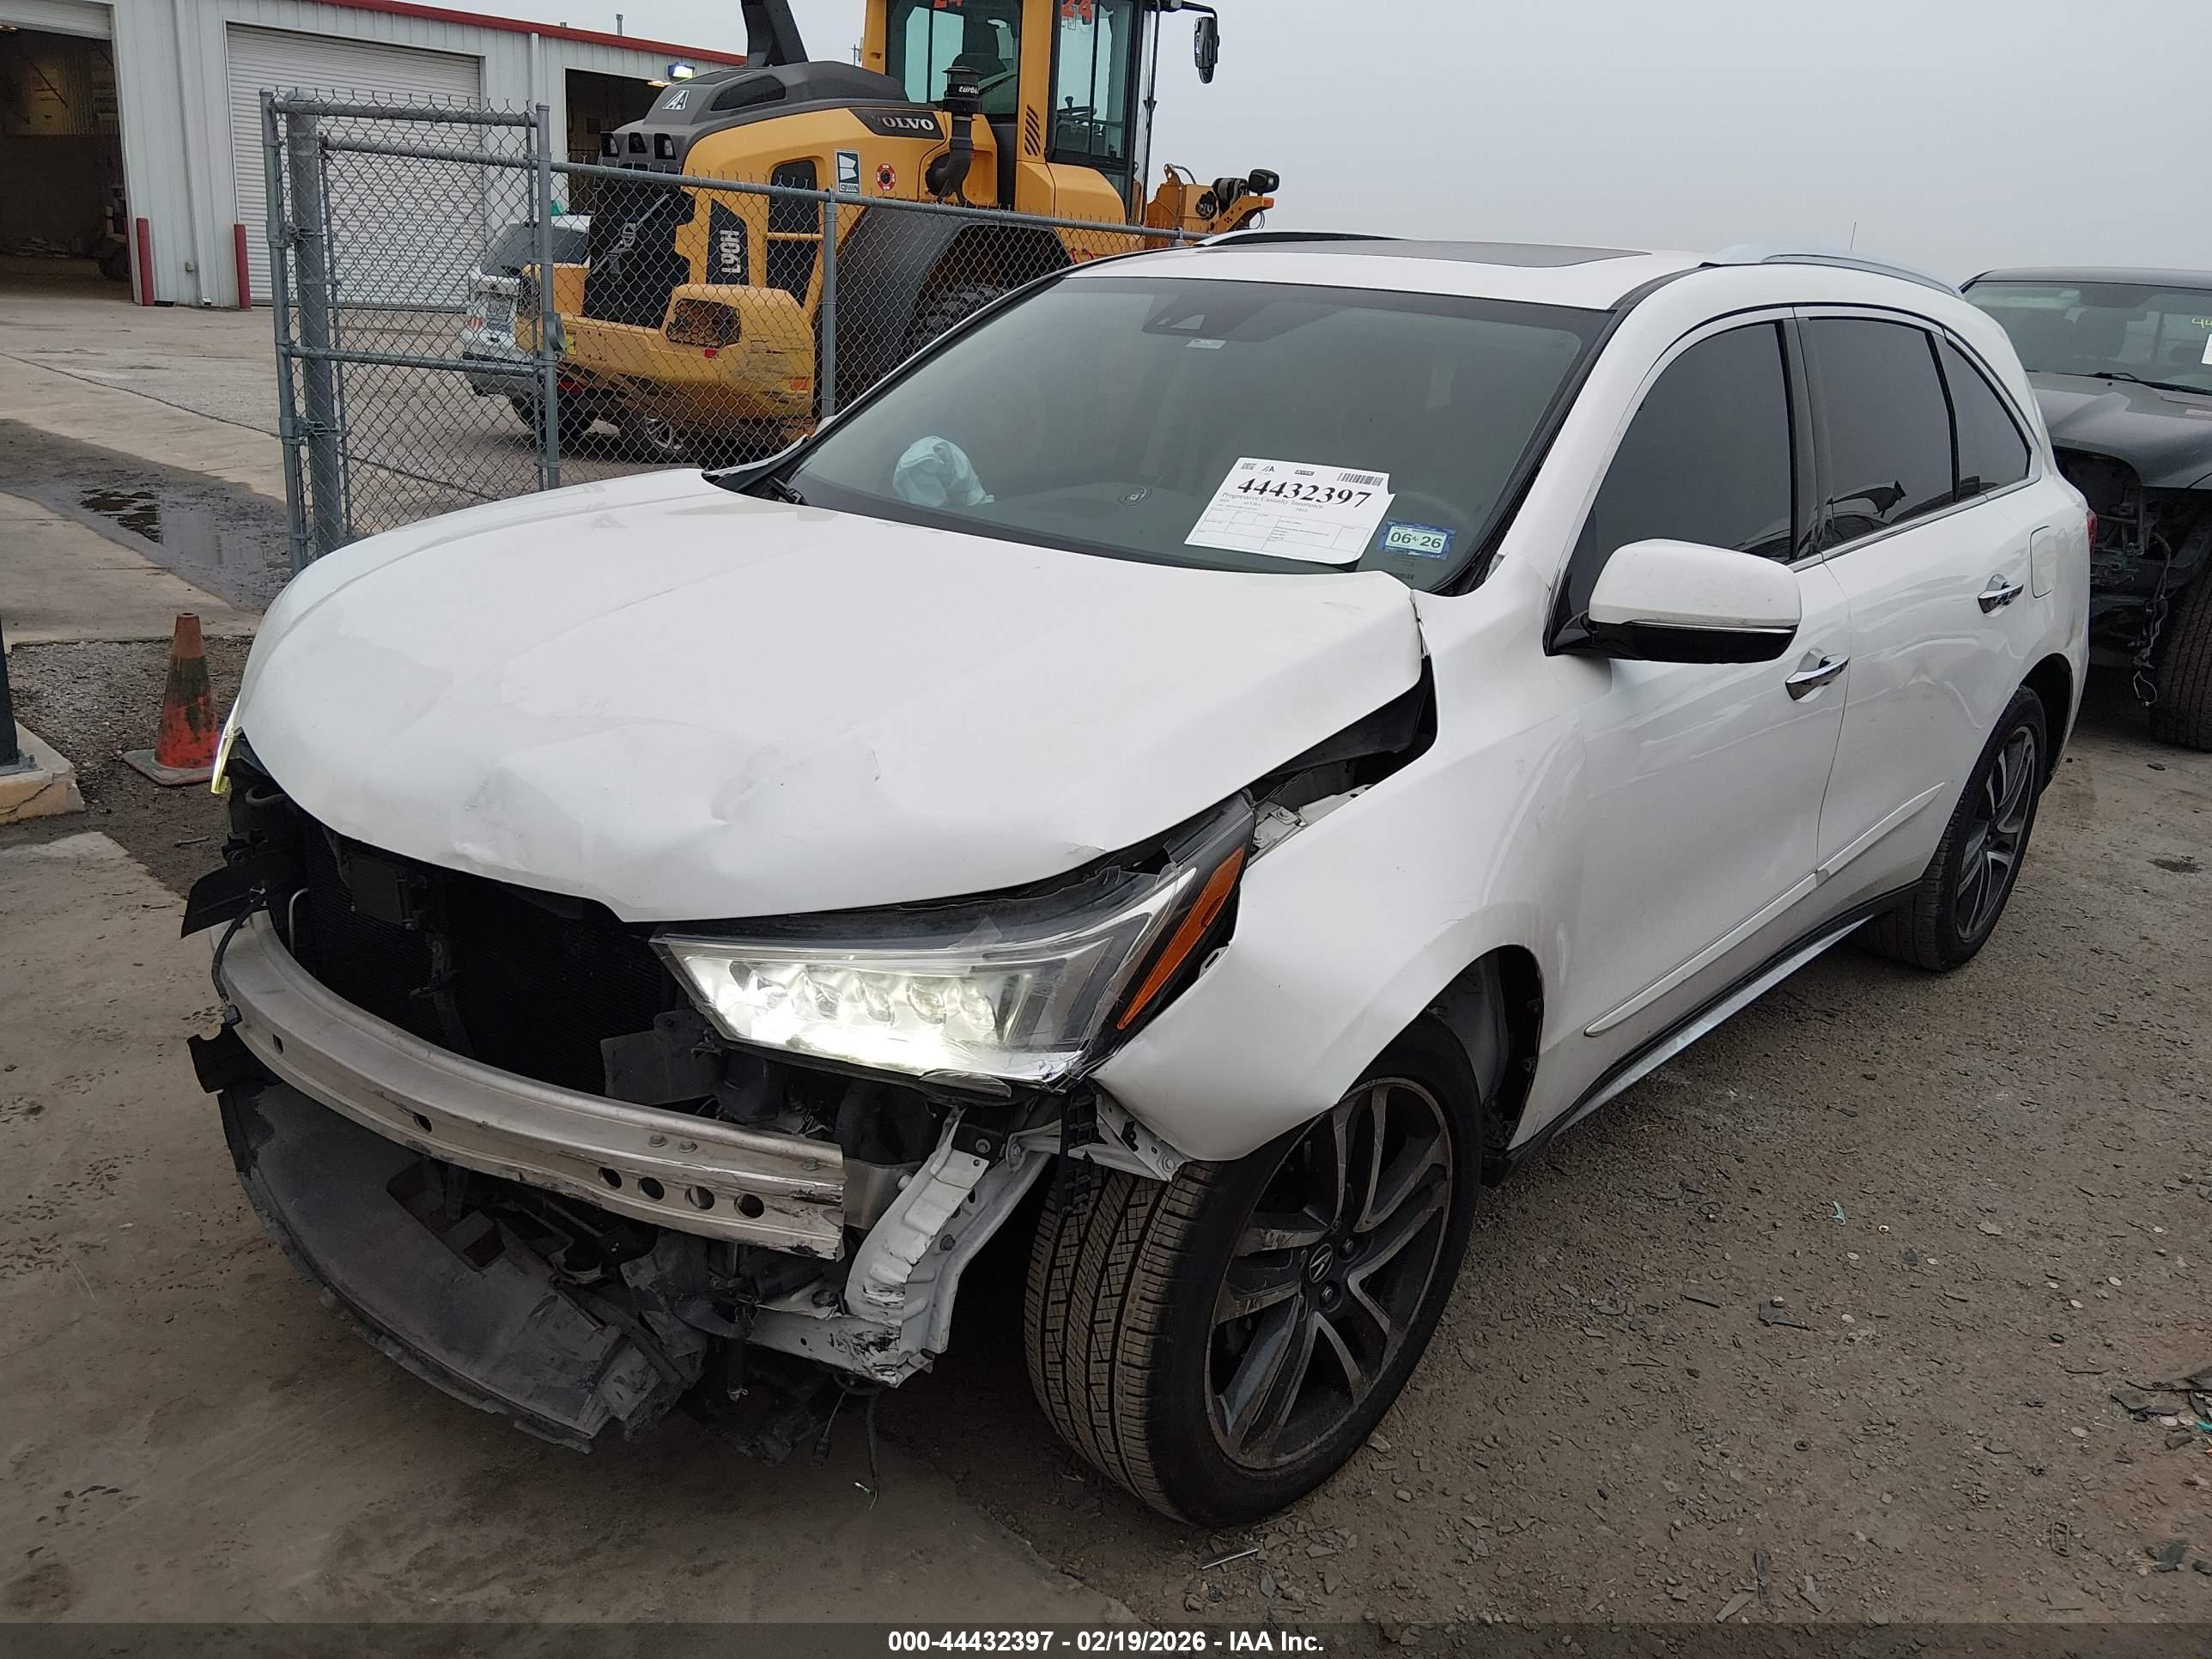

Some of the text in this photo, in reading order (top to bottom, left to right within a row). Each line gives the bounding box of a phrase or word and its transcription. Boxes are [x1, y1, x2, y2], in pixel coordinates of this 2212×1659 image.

[1237, 477, 1374, 508] 44432397
[1261, 496, 1289, 505] Casualty
[1291, 499, 1324, 509] Insurance
[1390, 532, 1443, 549] 06 26
